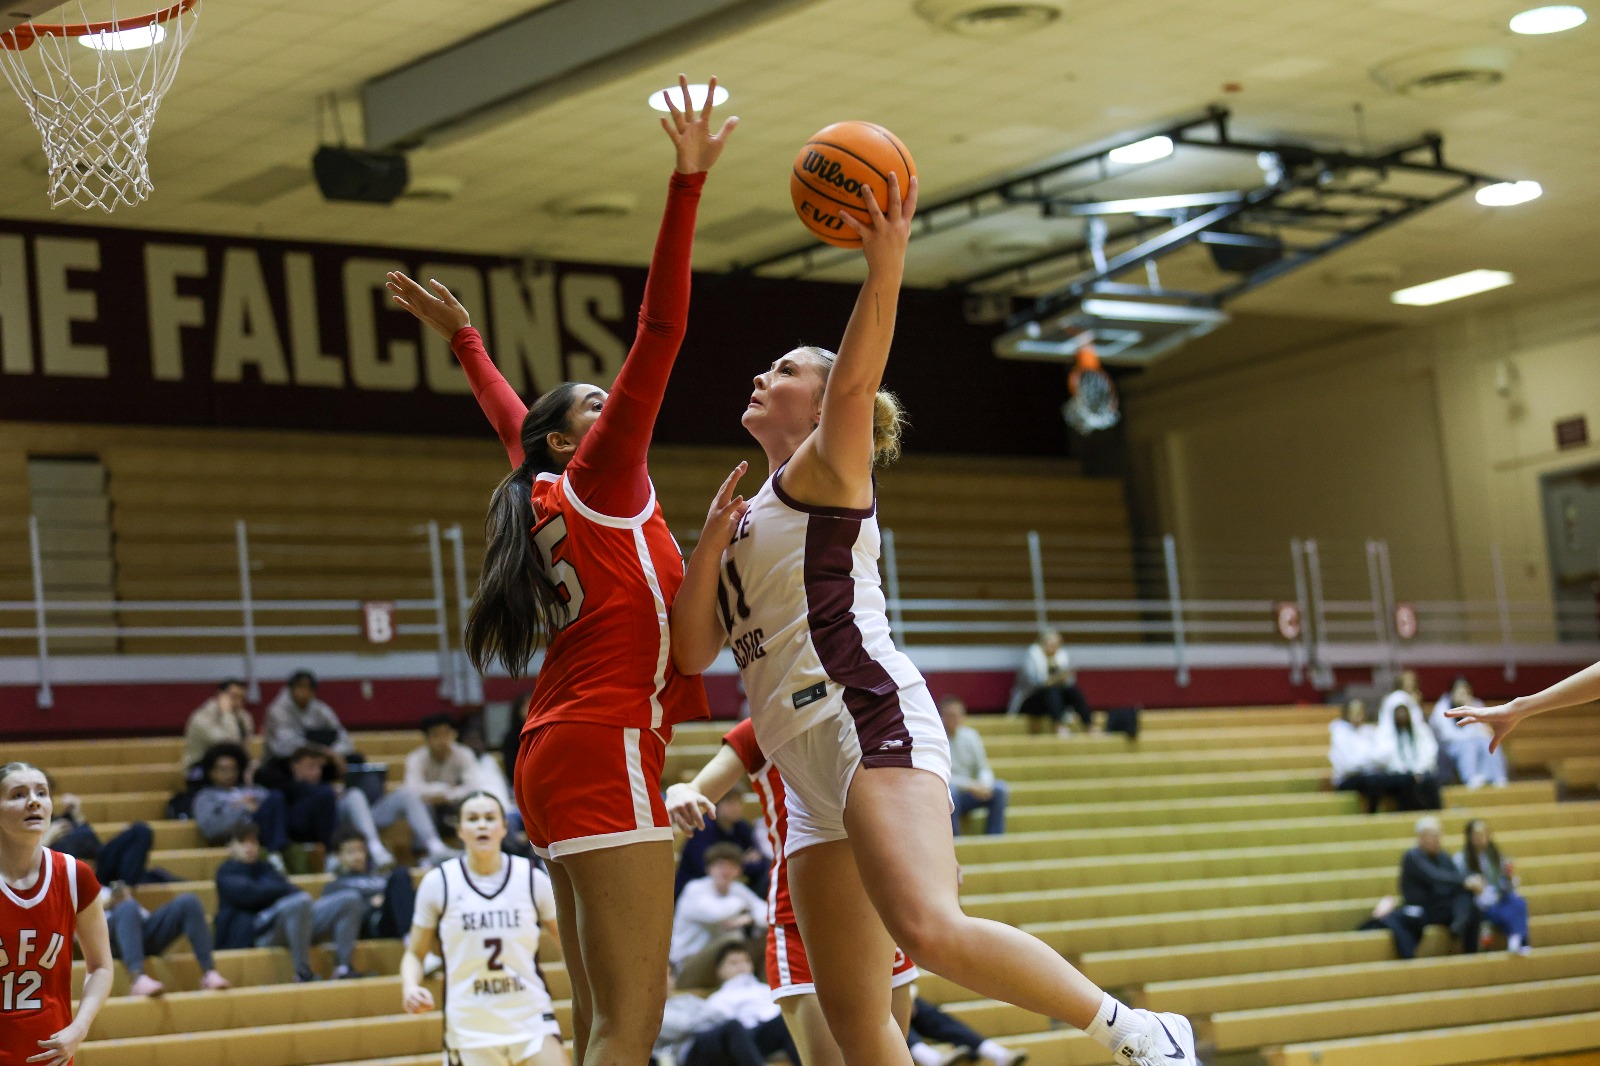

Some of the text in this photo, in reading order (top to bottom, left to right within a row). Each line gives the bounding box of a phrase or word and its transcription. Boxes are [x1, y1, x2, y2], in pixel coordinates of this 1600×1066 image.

[801, 200, 845, 230] EVO
[144, 242, 629, 398] FALCONS
[718, 556, 751, 636] 11
[462, 909, 521, 930] SEATTLE
[483, 938, 503, 971] 2
[2, 970, 42, 1010] 12
